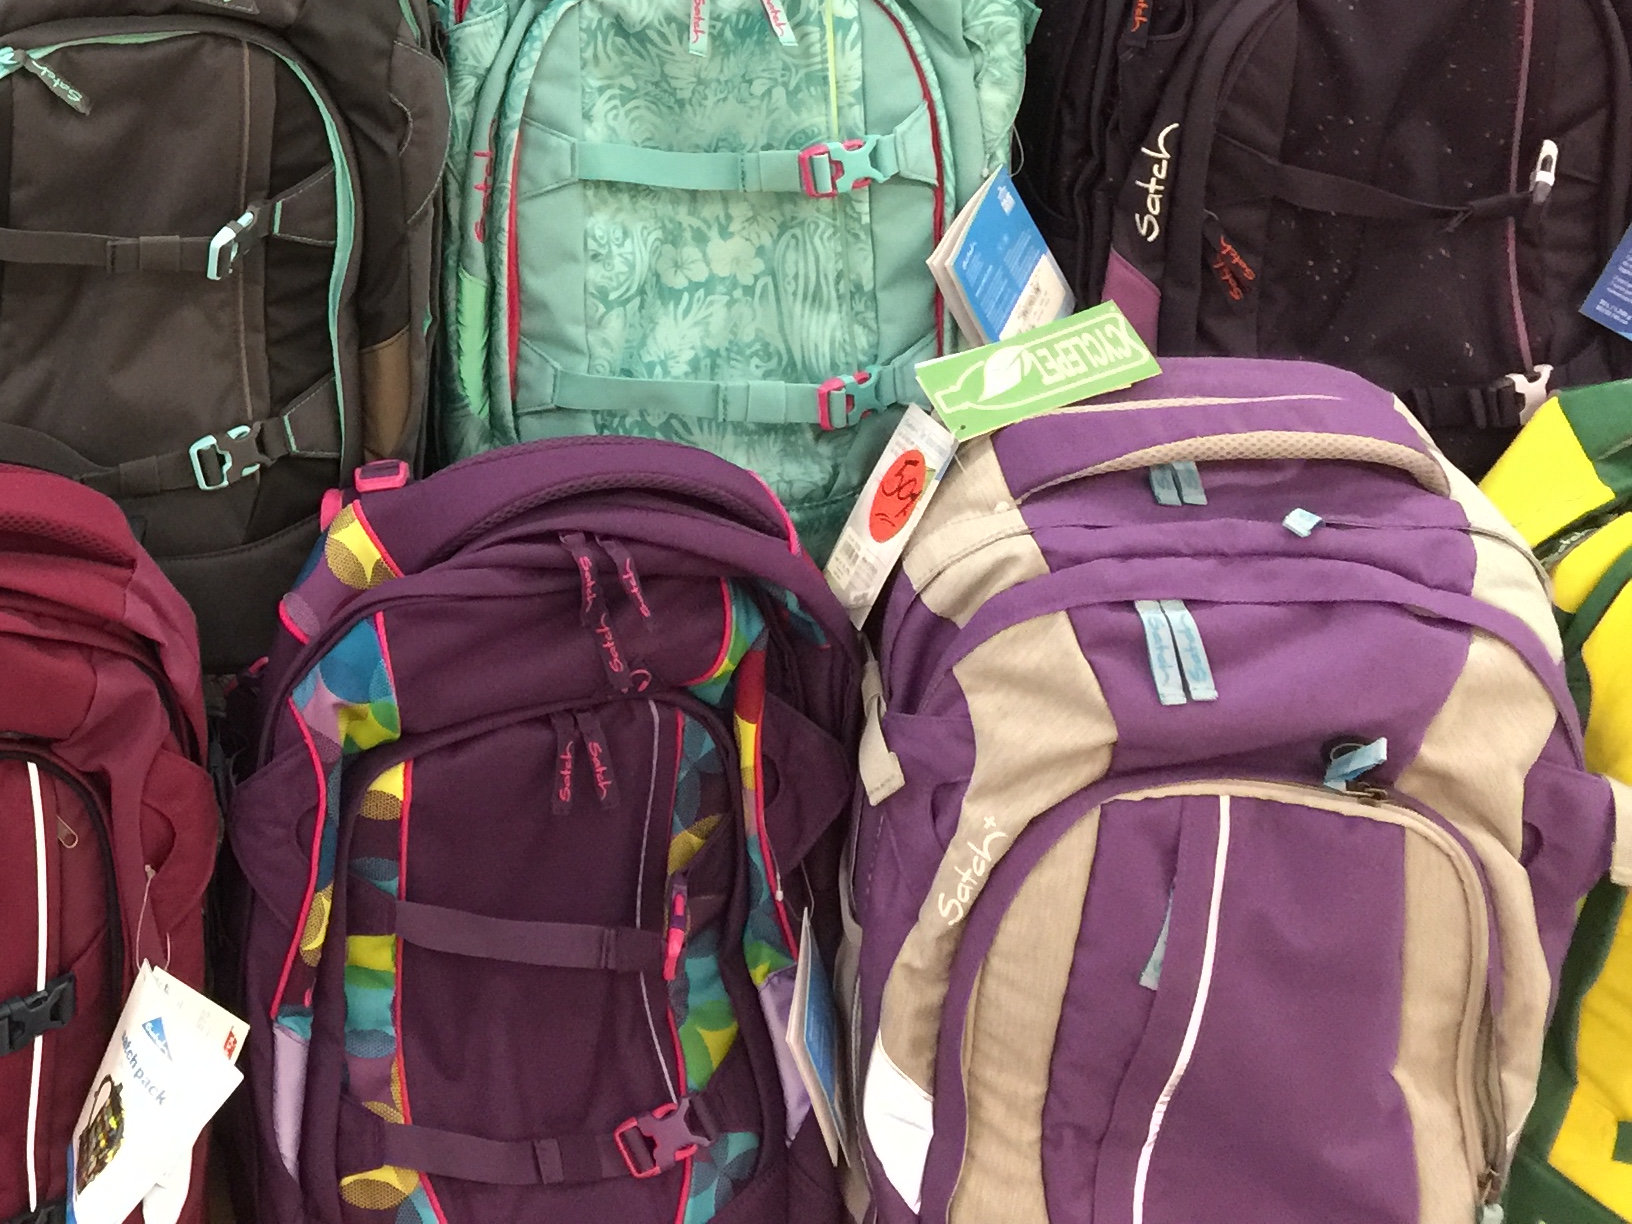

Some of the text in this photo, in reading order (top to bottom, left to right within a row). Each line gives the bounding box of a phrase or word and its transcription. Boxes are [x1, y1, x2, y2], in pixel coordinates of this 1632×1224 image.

[32, 60, 83, 102] Satch
[1134, 122, 1180, 243] Satch
[1221, 235, 1256, 281] Satch
[579, 555, 597, 614] Satch
[622, 557, 651, 618] Satch
[595, 613, 624, 673] Satch
[559, 740, 573, 802] Satch
[589, 741, 612, 801] Satch
[133, 1067, 166, 1106] pack
